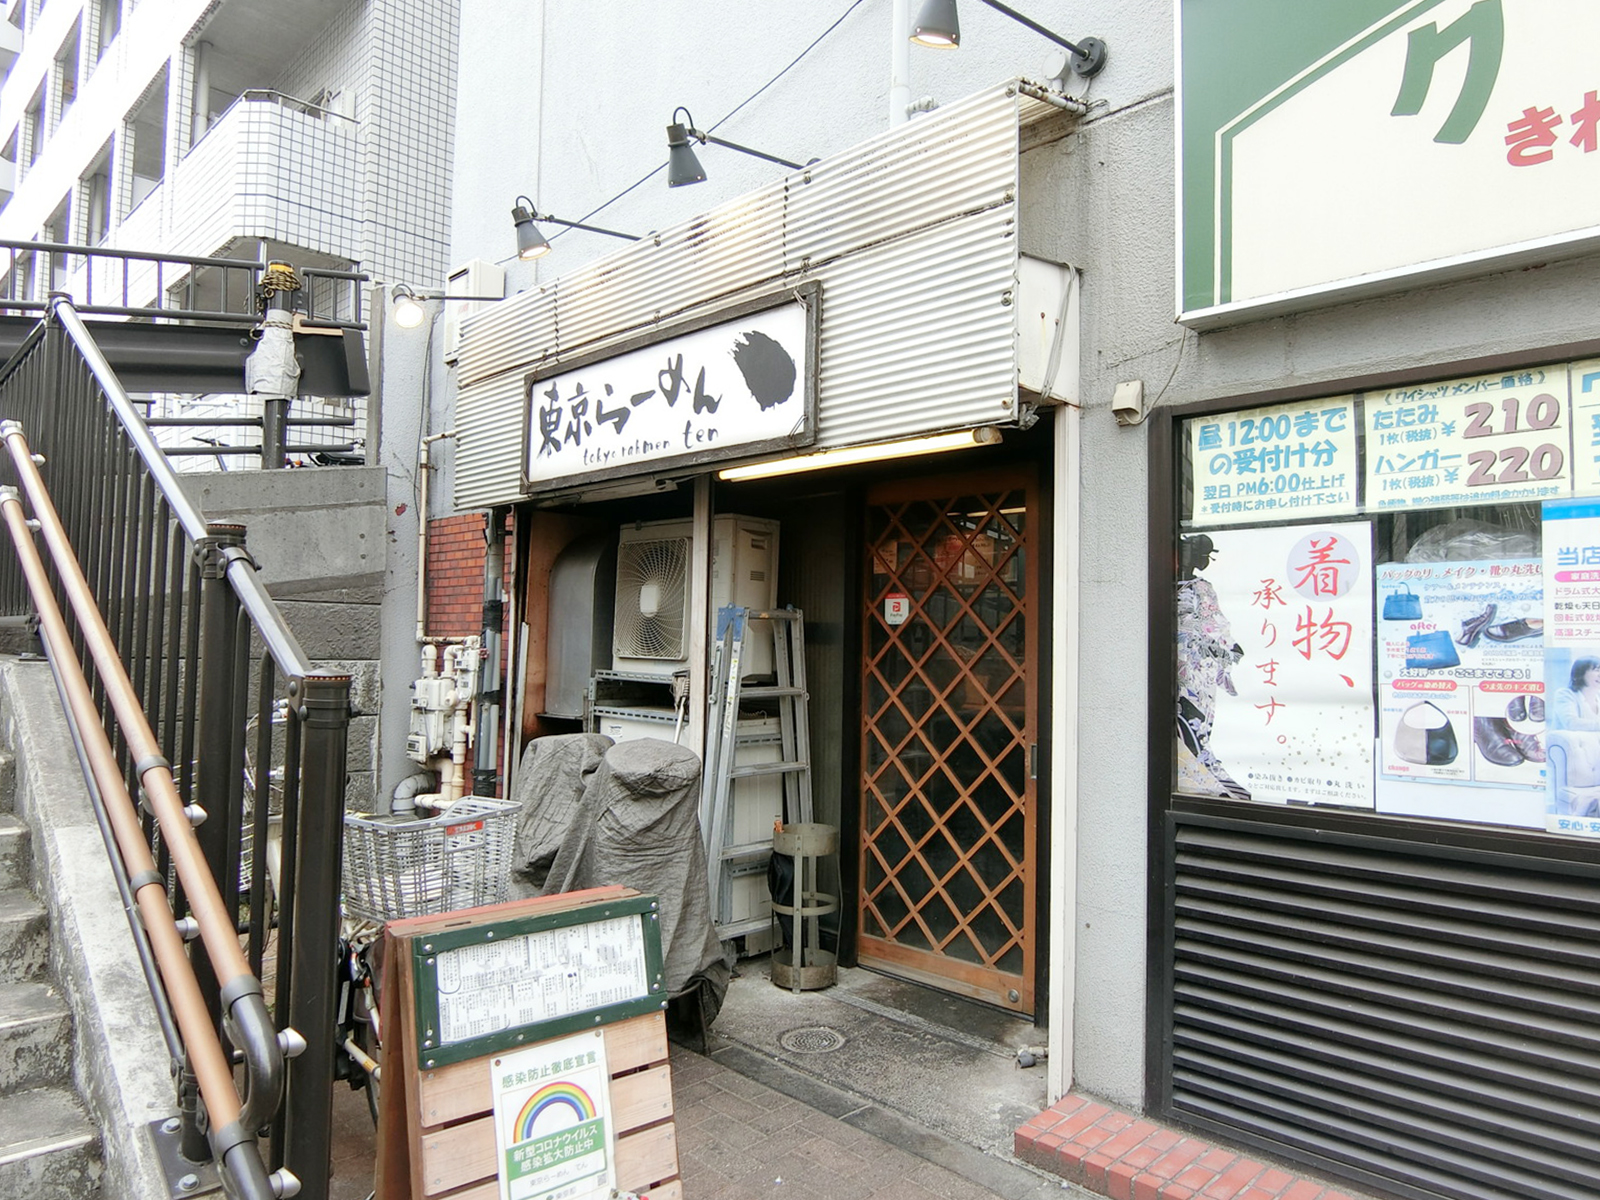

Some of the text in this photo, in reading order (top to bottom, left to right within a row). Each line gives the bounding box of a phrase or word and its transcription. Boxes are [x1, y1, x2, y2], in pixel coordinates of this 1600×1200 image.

[536, 352, 723, 461] 東京らーめん
[1373, 404, 1439, 430] たたみ
[583, 448, 617, 466] tokyo
[682, 419, 719, 449] ten
[1379, 427, 1437, 446] 1枚(税抜)
[1209, 439, 1338, 476] の受付け分
[1374, 448, 1462, 474] ハンガー
[1203, 484, 1231, 500] 翌日
[1382, 474, 1440, 491] 1枚(税抜)
[1557, 546, 1600, 566] 当店
[1410, 622, 1437, 630] after
[1252, 578, 1288, 744] 承ります。
[502, 1050, 597, 1088] 感染防止徹底宣言
[513, 1124, 598, 1162] 新型コロナウイルス
[520, 1139, 594, 1172] 感染拡大防止中
